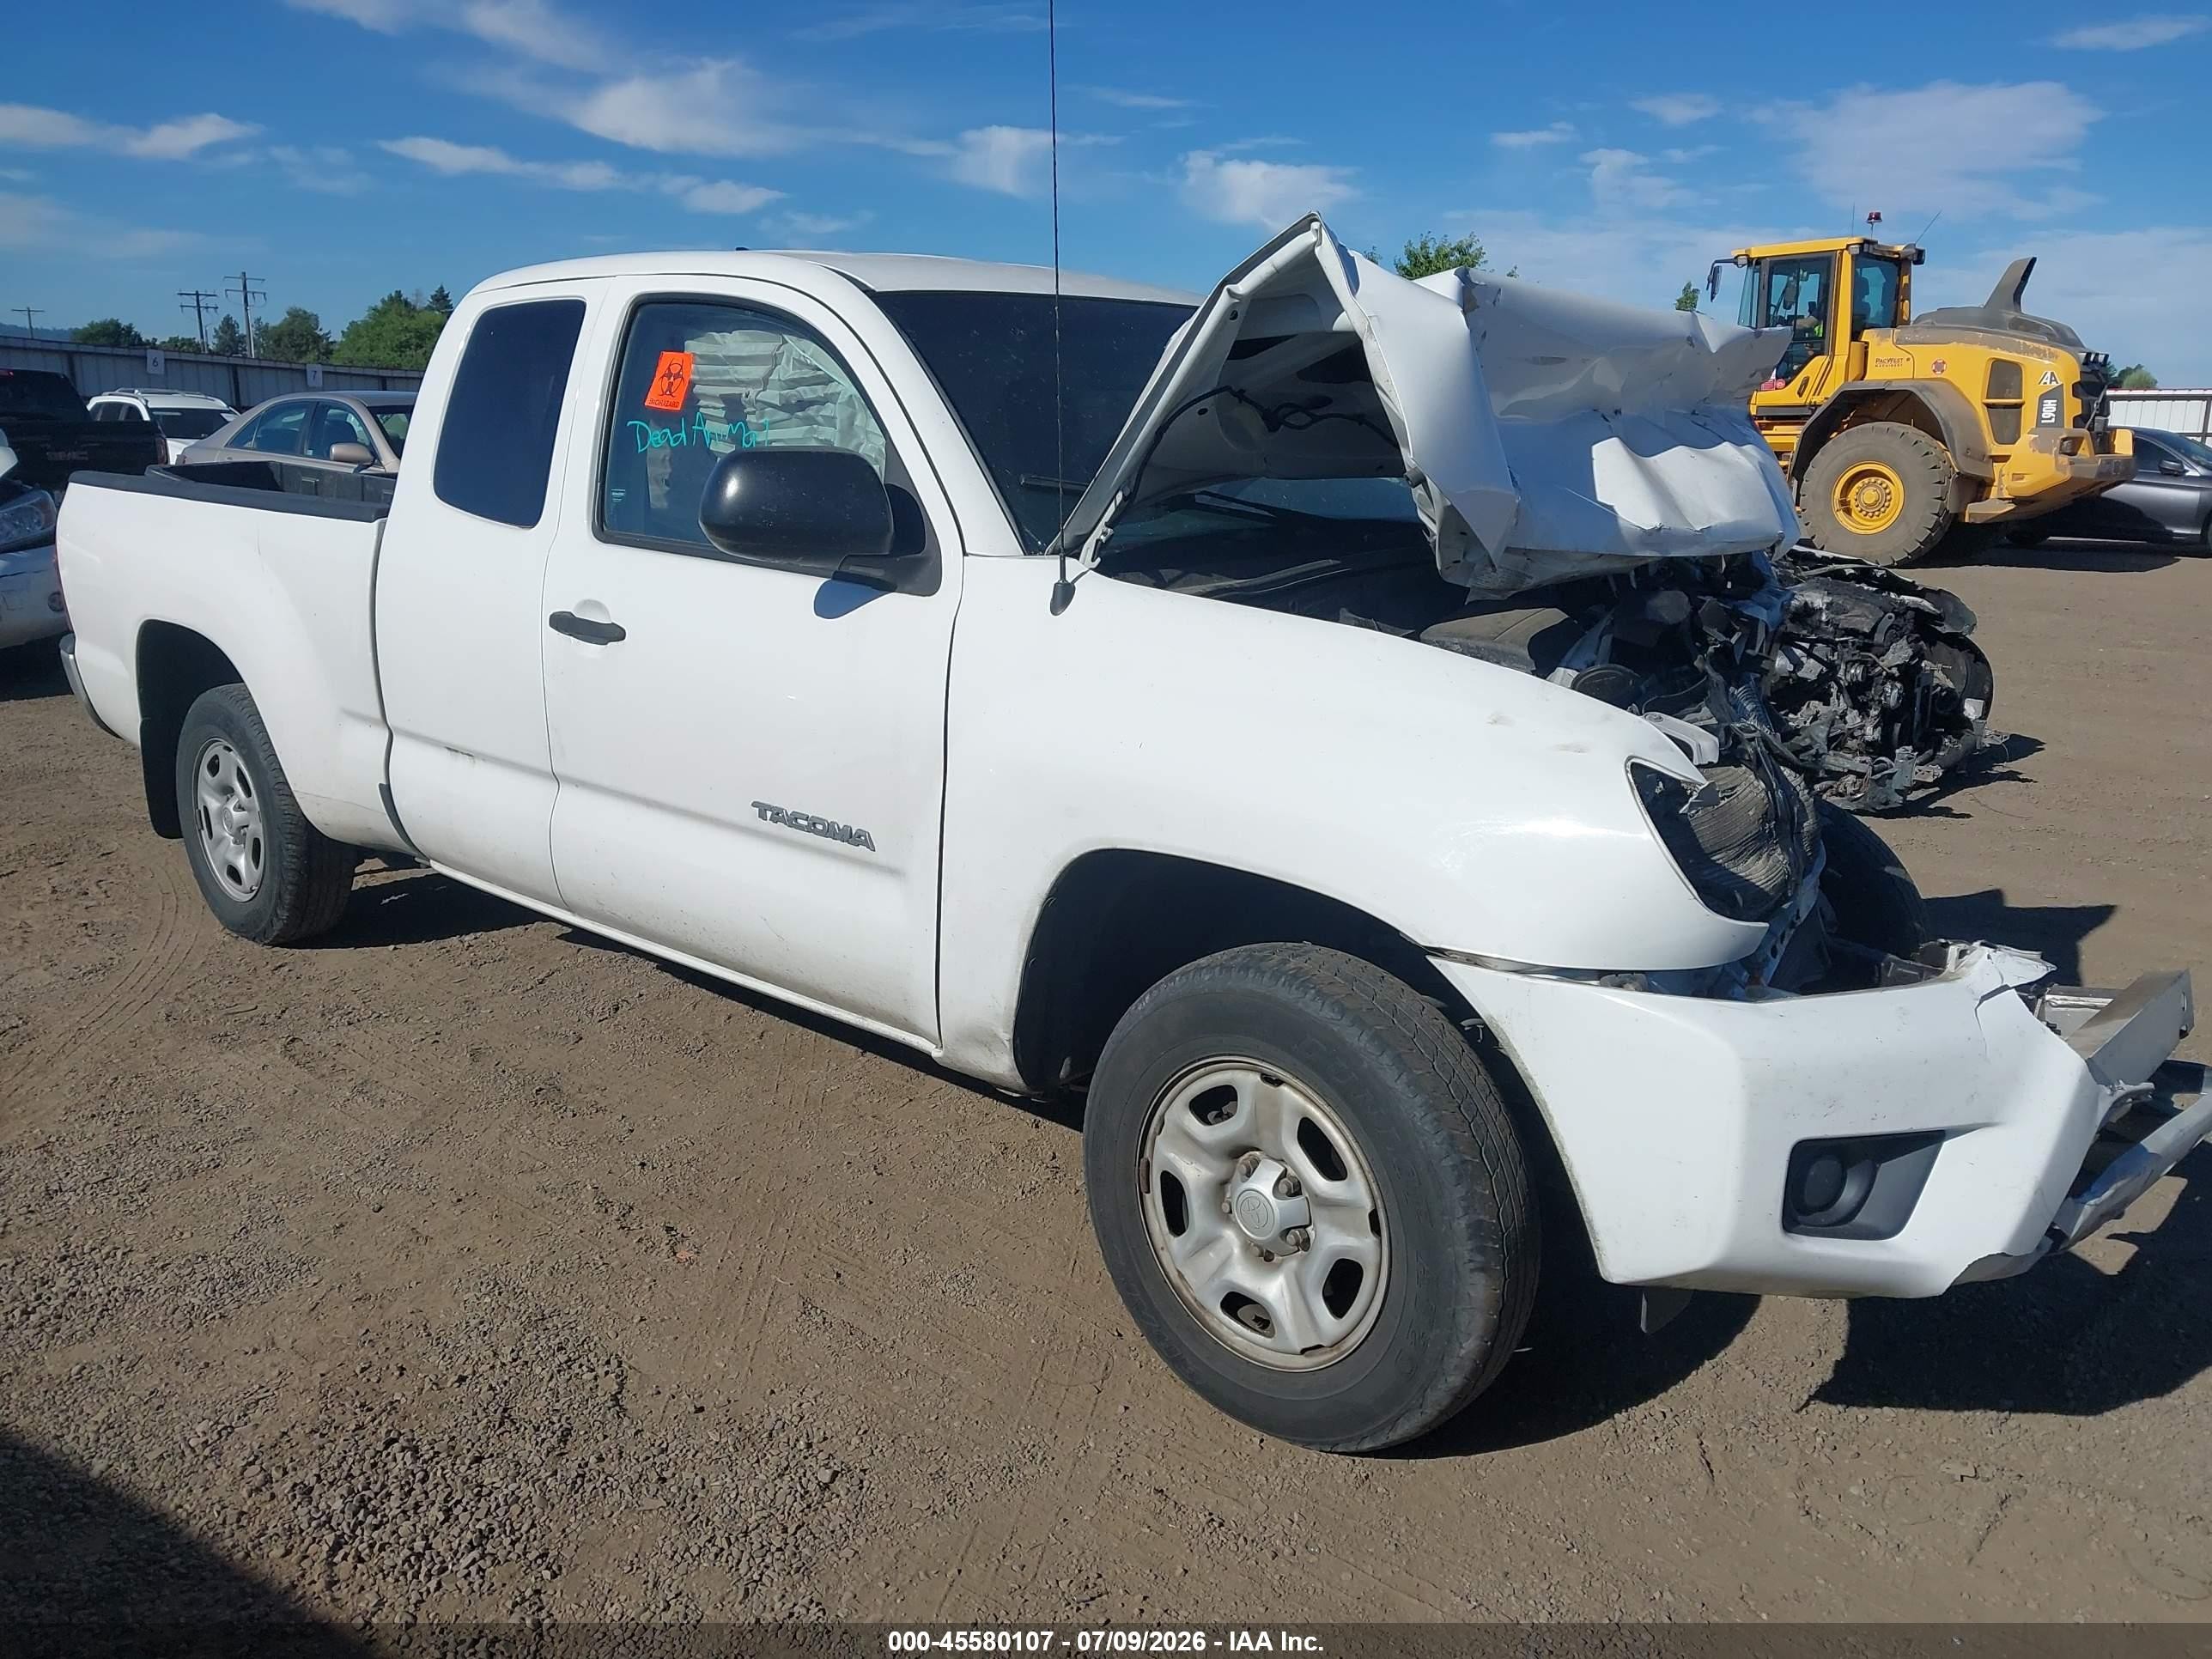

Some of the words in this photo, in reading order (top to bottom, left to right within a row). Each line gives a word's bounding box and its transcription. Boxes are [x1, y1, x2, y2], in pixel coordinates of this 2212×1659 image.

[152, 358, 159, 368] 6
[310, 370, 318, 380] 7
[648, 398, 680, 408] BIOHAZARD
[2040, 398, 2057, 423] L90H
[627, 416, 687, 453] Dead
[750, 800, 876, 852] TACOMA
